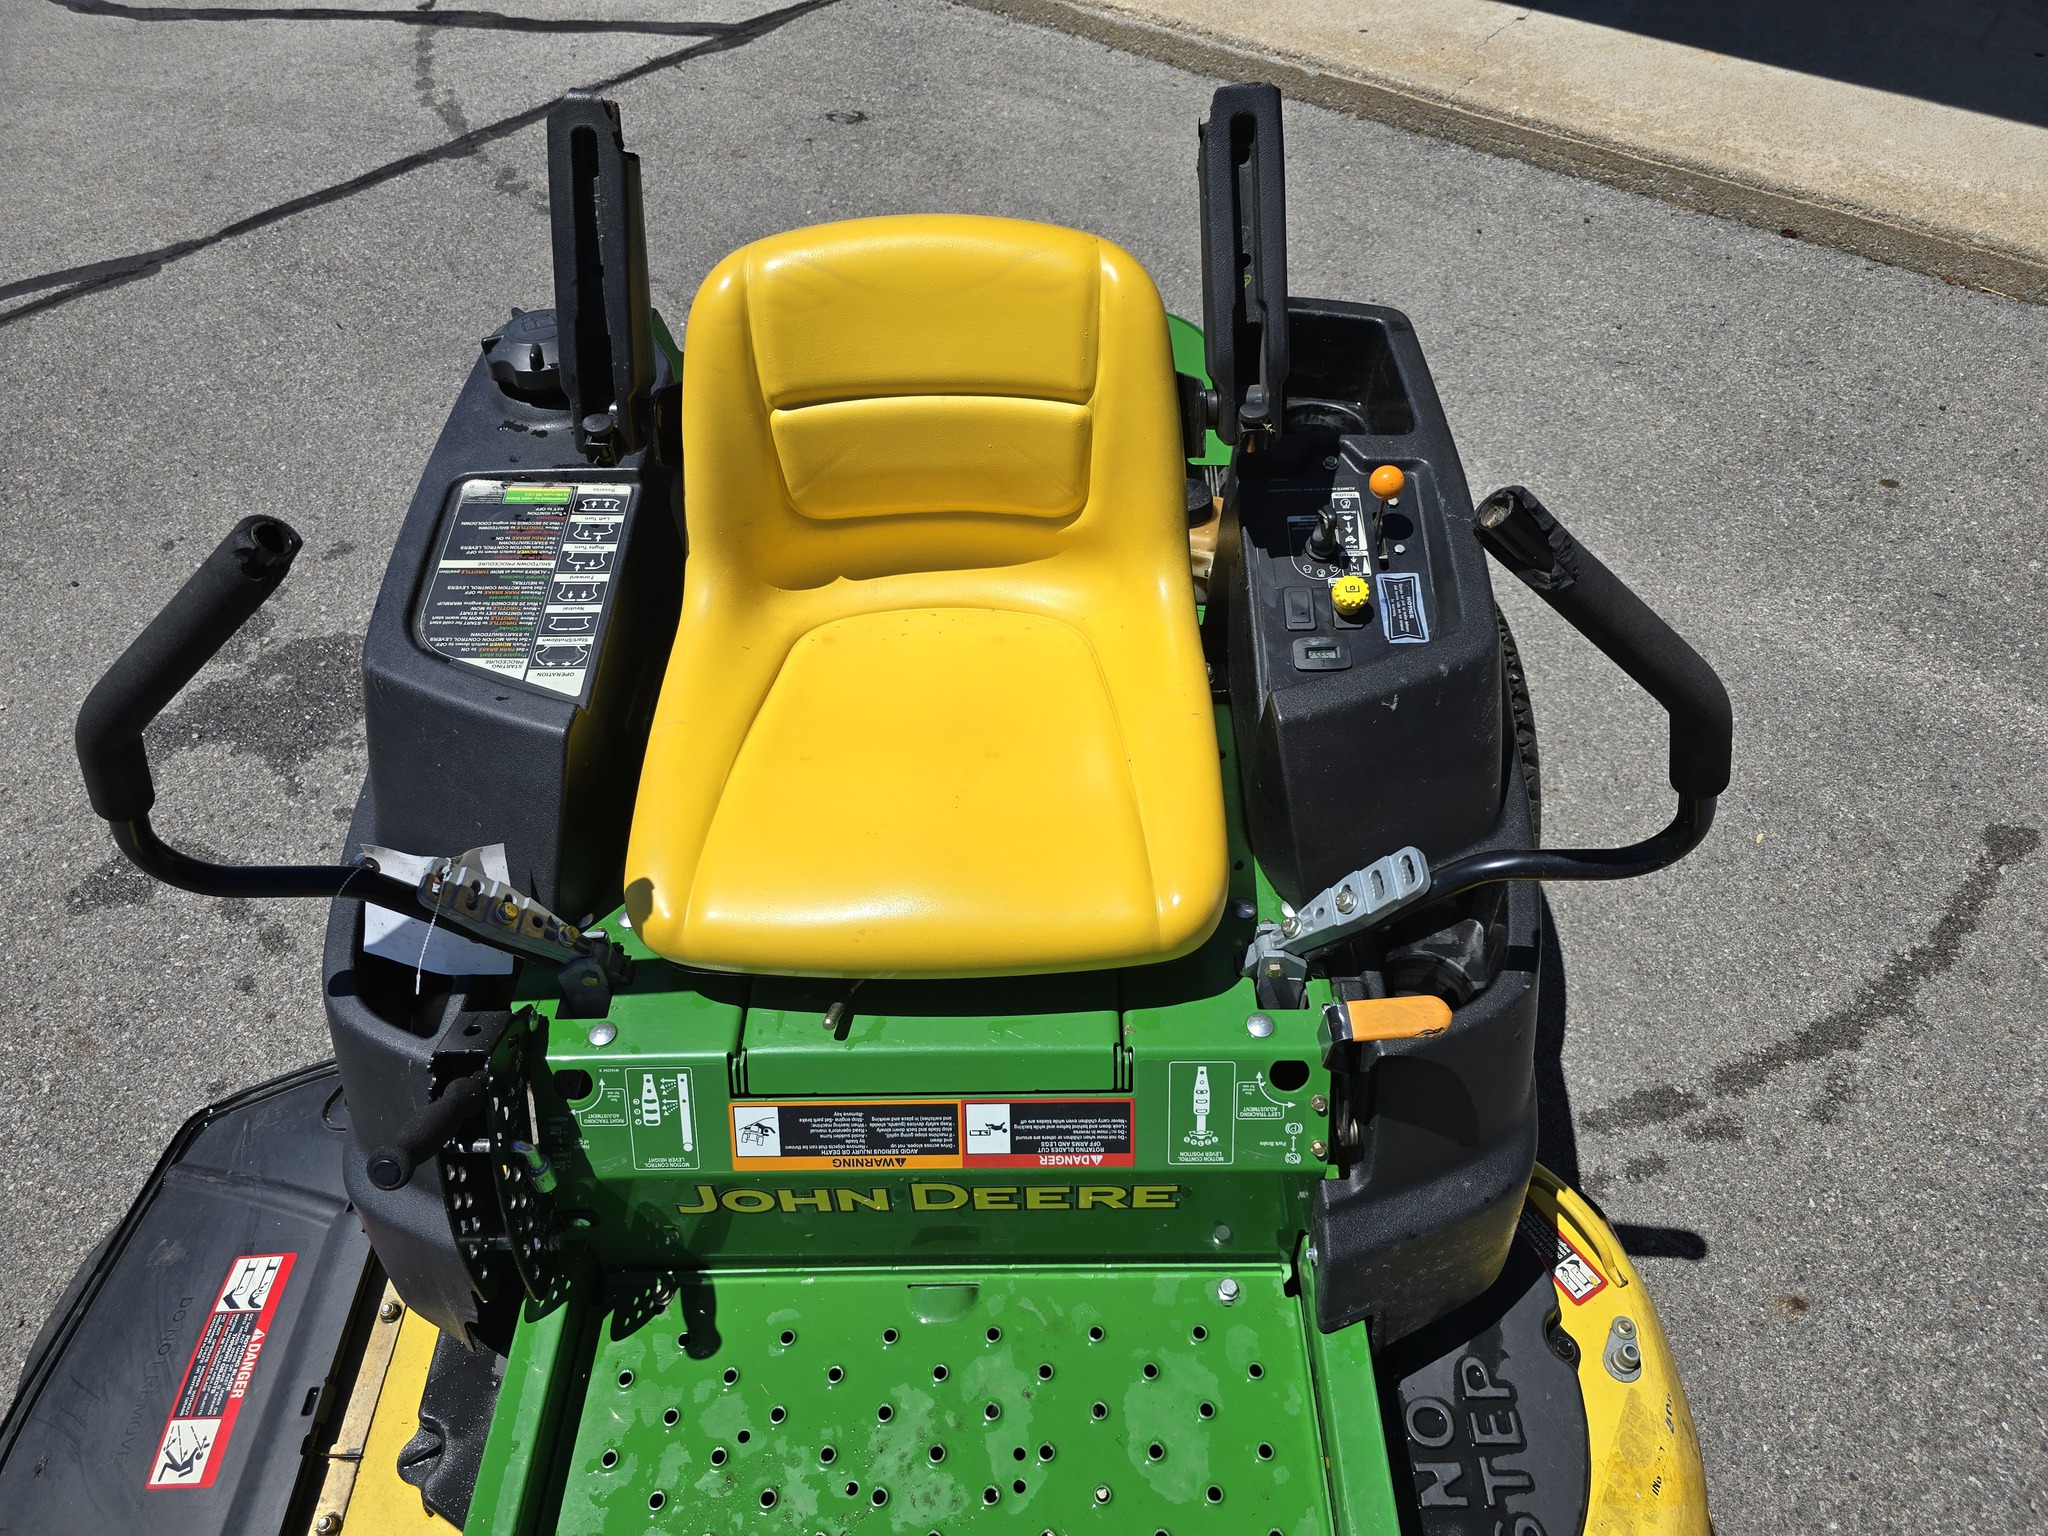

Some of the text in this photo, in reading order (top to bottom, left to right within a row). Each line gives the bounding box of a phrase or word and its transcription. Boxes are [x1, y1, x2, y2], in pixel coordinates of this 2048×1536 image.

[1405, 596, 1414, 619] NOTICE
[832, 1158, 894, 1167] WARNING
[1039, 1155, 1090, 1165] DANGER
[675, 1183, 1181, 1215] JOHN DEERE
[113, 1297, 193, 1466] DO NOT REMOVE
[210, 1333, 238, 1394] THROWN OBJECTS
[226, 1335, 251, 1392] ROTATING BLADE
[230, 1343, 262, 1398] DANGER
[1406, 1397, 1468, 1507] NO
